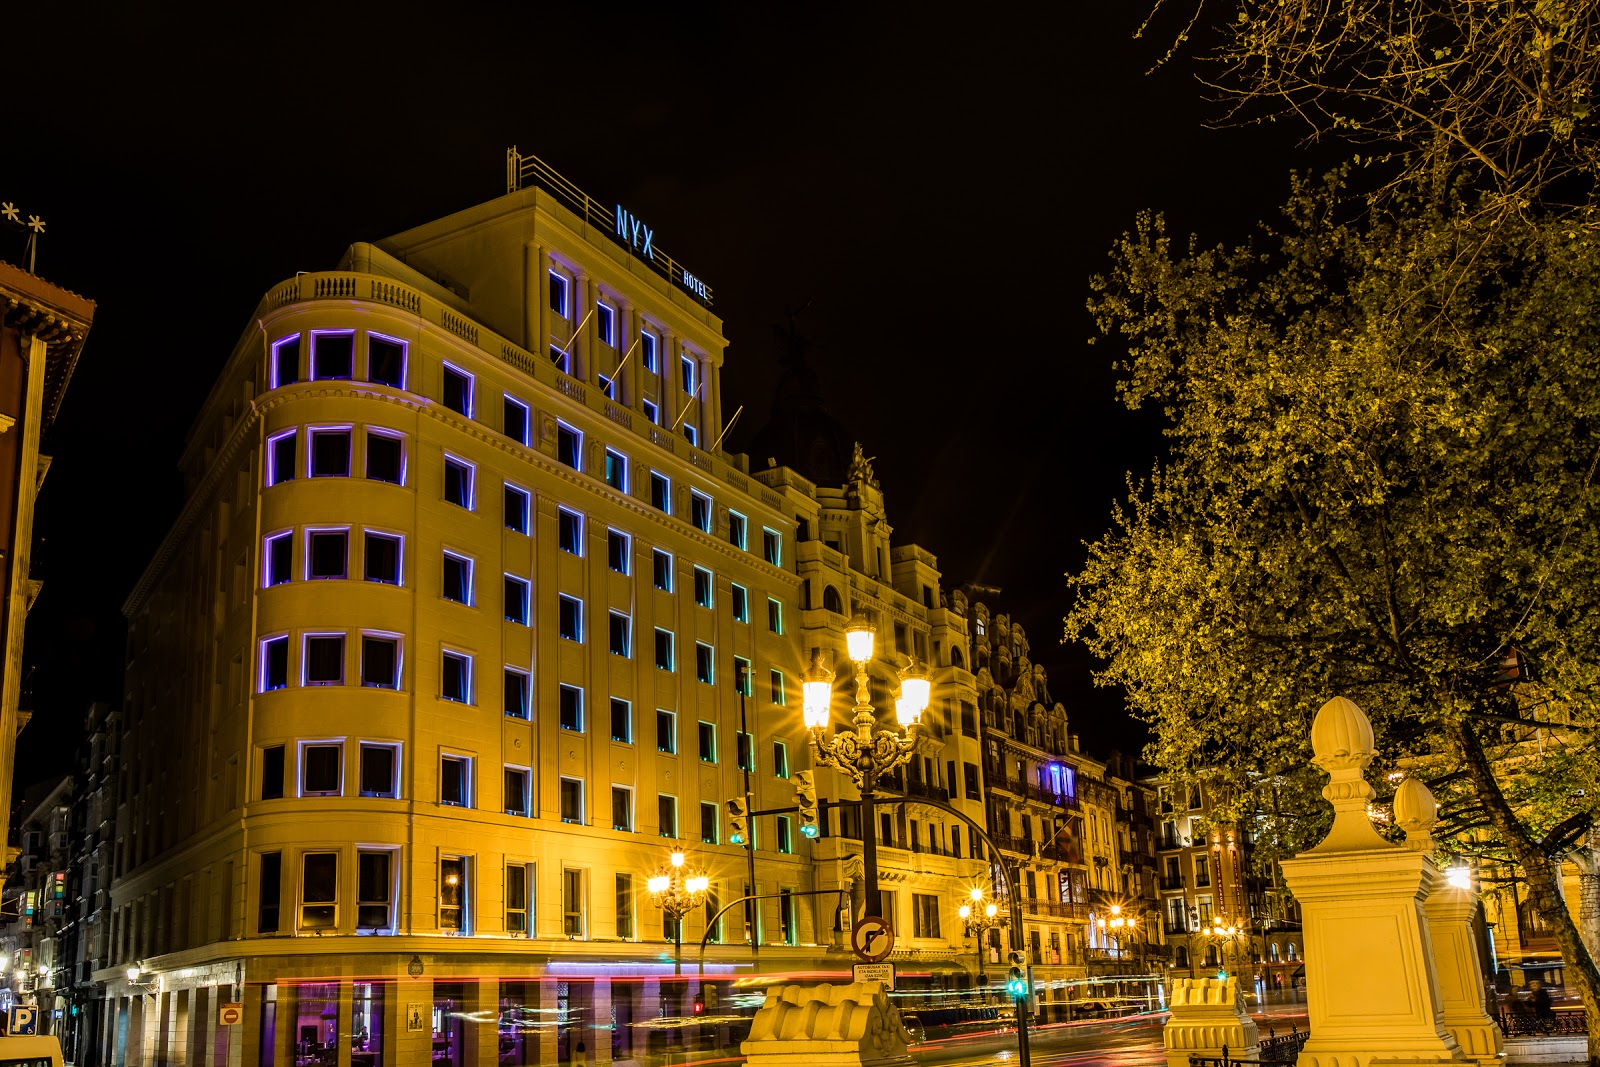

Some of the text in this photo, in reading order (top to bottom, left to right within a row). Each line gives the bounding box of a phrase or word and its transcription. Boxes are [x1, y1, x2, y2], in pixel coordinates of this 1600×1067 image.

[616, 204, 708, 300] NYX HOTEL
[14, 1009, 32, 1032] P
